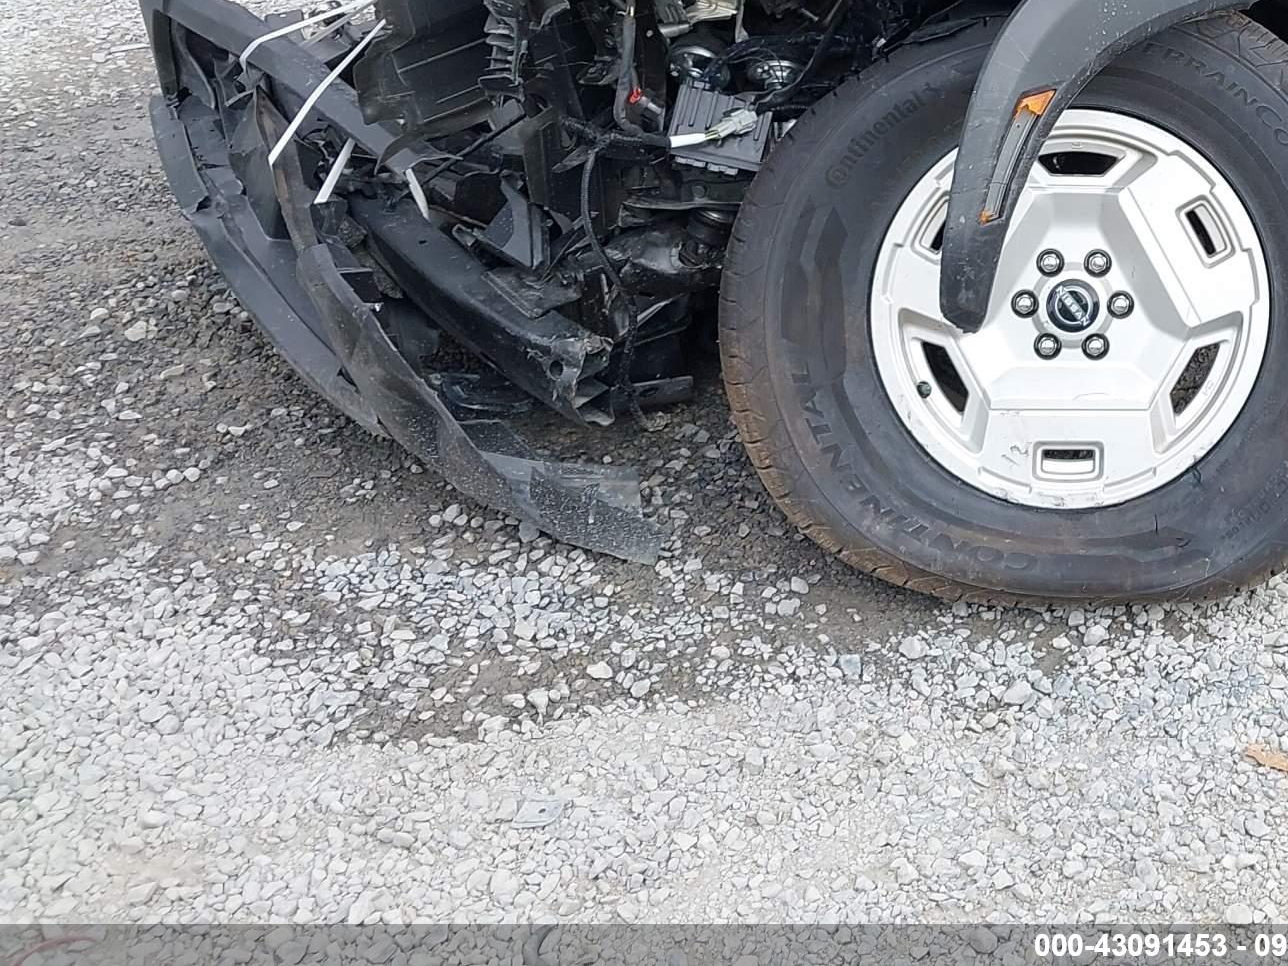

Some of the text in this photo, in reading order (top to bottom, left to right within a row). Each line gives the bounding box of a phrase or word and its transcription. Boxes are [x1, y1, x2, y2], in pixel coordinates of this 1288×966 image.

[824, 87, 930, 190] Continental
[1055, 285, 1091, 327] NISSAN
[791, 363, 1038, 571] CONTINENTAL
